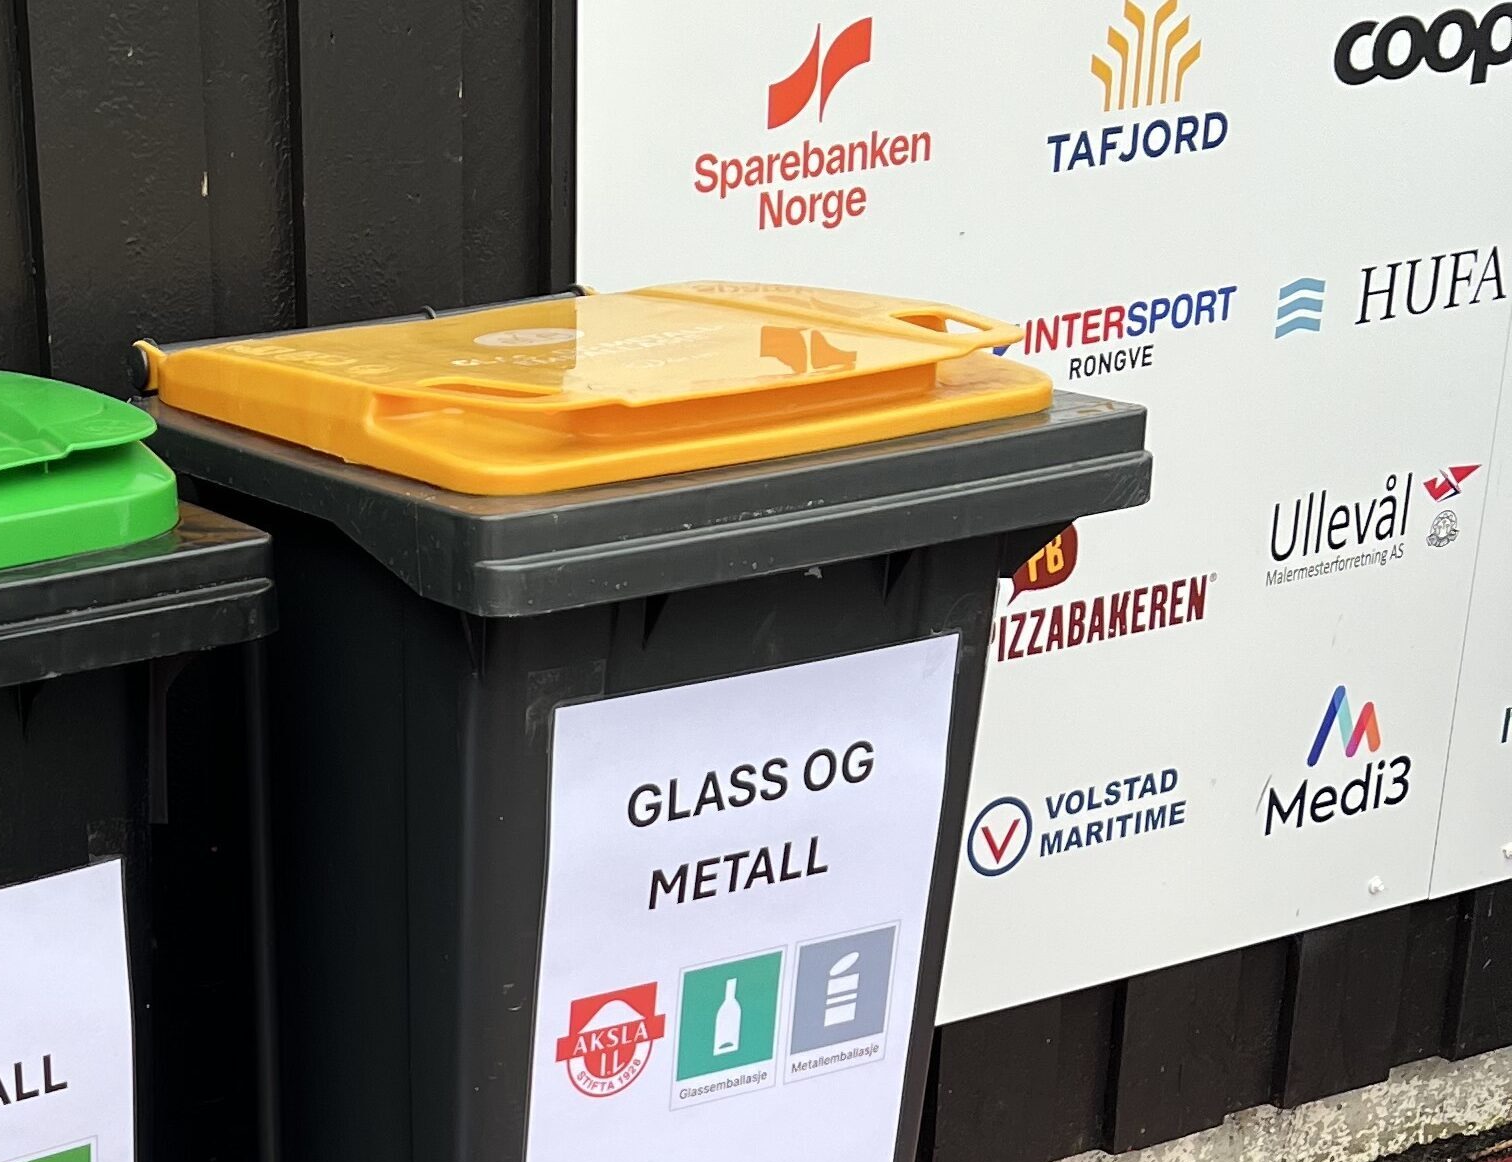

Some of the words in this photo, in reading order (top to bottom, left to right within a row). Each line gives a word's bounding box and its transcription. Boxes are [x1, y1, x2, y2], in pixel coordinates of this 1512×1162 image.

[1334, 1, 1512, 86] coop
[694, 130, 931, 199] Sparebanken
[1047, 110, 1229, 173] TAFJORD
[759, 186, 867, 230] Norge
[1355, 246, 1507, 325] HUFA
[1024, 285, 1237, 355] INTERSPORT
[1069, 344, 1154, 380] RONGVE
[1271, 472, 1413, 562] Ullevål
[1265, 549, 1387, 587] Malermesterforretning
[1390, 543, 1405, 561] AS
[627, 757, 789, 828] GLASS
[803, 740, 875, 792] OG
[1045, 768, 1179, 820] VOLSTAD
[1263, 755, 1412, 836] Medi3
[1039, 800, 1187, 858] MARITIME
[647, 836, 829, 909] METALL
[572, 1020, 649, 1056] AKSLA
[791, 1042, 880, 1074] Metallemballasje
[576, 1070, 616, 1092] STIFTA
[679, 1069, 768, 1100] Glassemballasje
